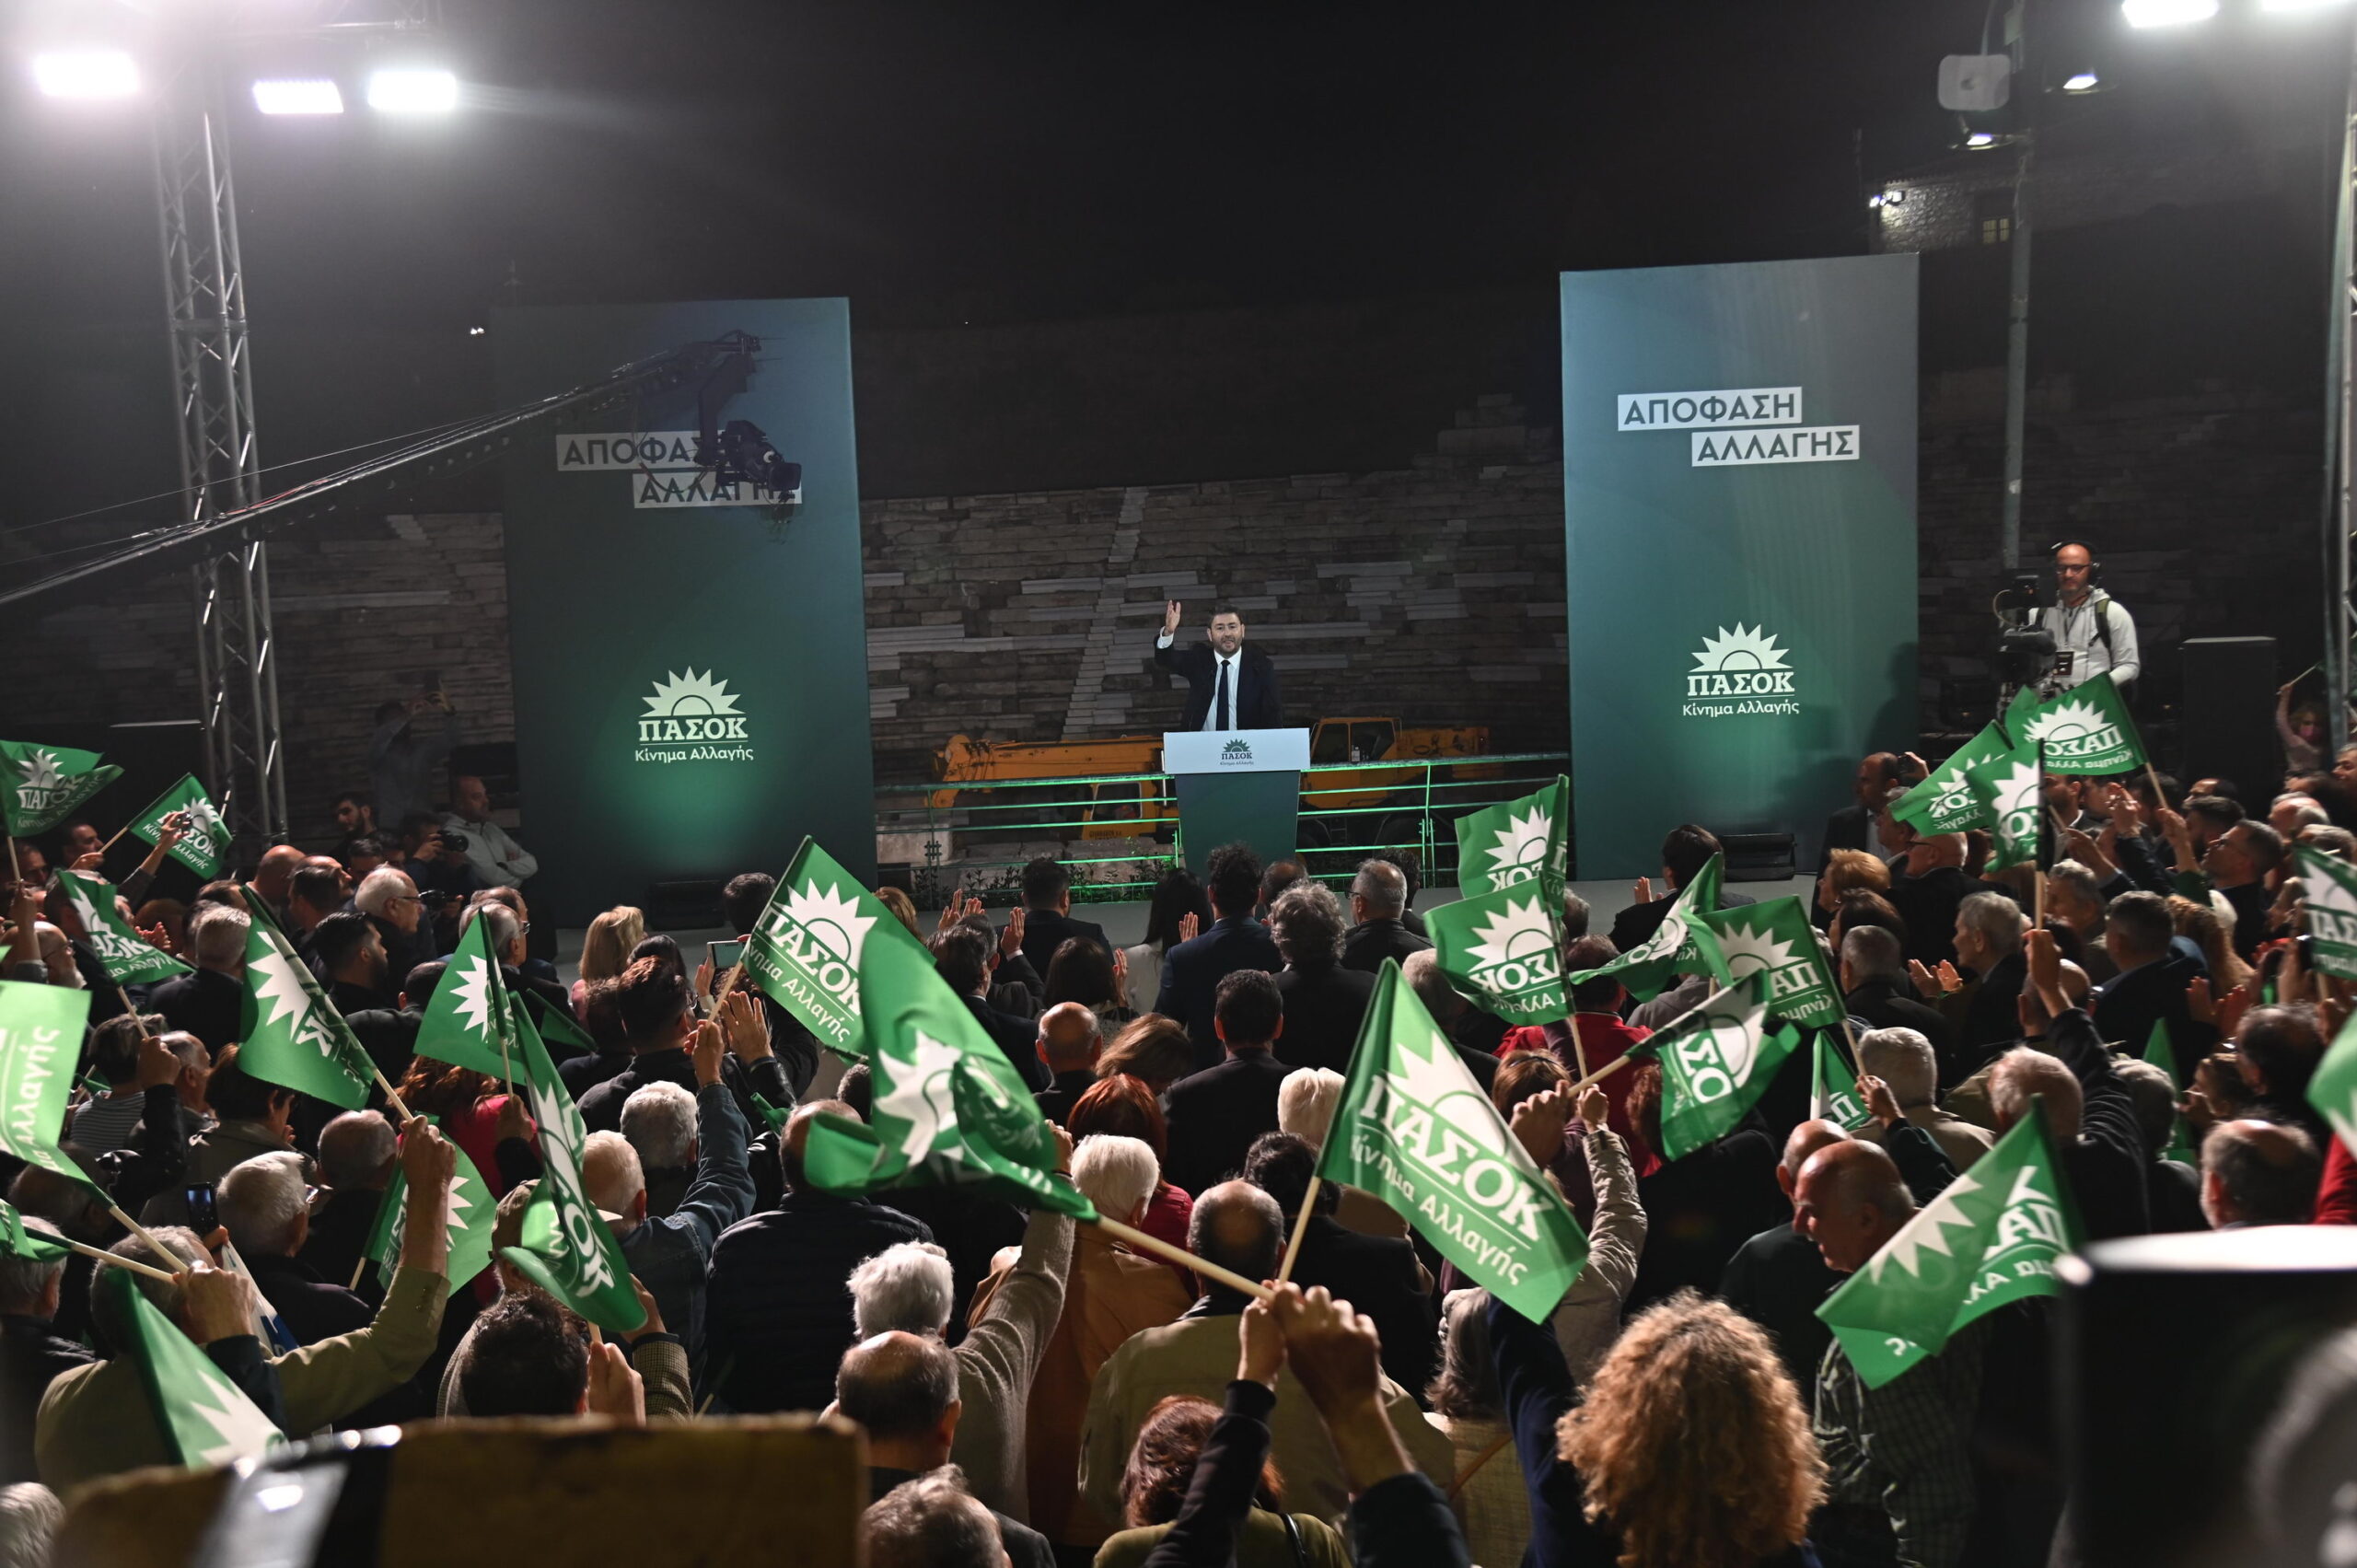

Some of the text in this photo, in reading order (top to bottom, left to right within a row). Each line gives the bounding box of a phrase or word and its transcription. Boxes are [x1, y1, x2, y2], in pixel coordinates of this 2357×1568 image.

[1624, 393, 1795, 425] ΑΠΟΦΑΣΗ
[563, 436, 702, 466] ΑΠΟΦΑ
[1697, 430, 1853, 461] ΑΛΛΑΓΗΣ
[1687, 671, 1795, 696] ΠΑΣΟΚ
[1682, 699, 1800, 717] Κίνημα Αλλαγής
[638, 717, 749, 741] ΠΑΣΟΚ
[634, 745, 754, 763] Κίνημα Αλλαγής
[1221, 752, 1253, 761] ΠΑΣΟΚ
[757, 906, 862, 1016] ΠΑΣΟΚ
[748, 938, 851, 1043] νημα Αλλαγής
[1359, 1074, 1555, 1242] ΠΑΣΟΚ
[1419, 1194, 1528, 1286] Αλλαγής
